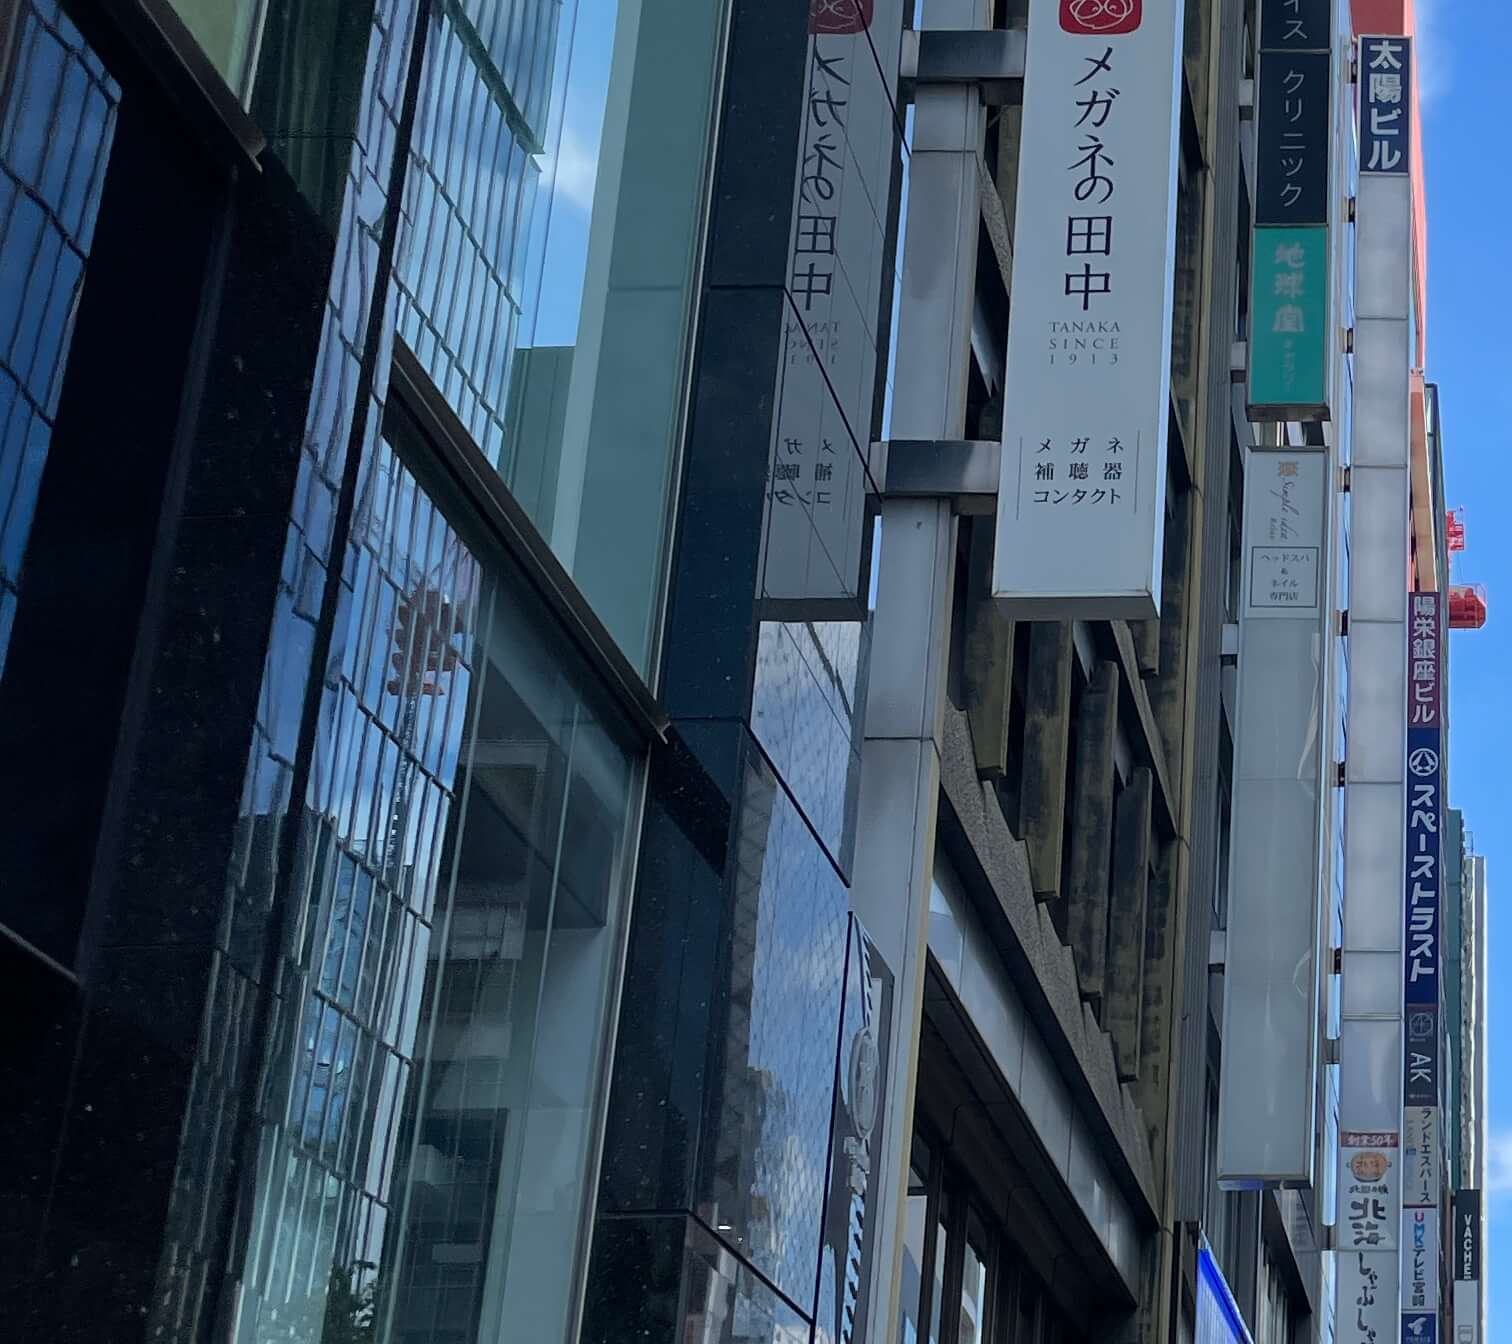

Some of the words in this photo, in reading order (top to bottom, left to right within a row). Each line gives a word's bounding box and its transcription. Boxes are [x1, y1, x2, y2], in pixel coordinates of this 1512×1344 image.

[1368, 40, 1402, 171] 太陽ビル
[1064, 47, 1119, 311] メガネの田中
[1048, 320, 1122, 336] TANAKA
[1048, 338, 1121, 353] SINCE
[1035, 436, 1125, 455] メガネ
[1032, 488, 1122, 507] コンタクト
[1412, 596, 1436, 724] 陽栄銀座ビル
[1409, 784, 1437, 982] スペーストラスト
[1410, 1052, 1432, 1083] AK
[1420, 1107, 1432, 1202] ランドエスパース
